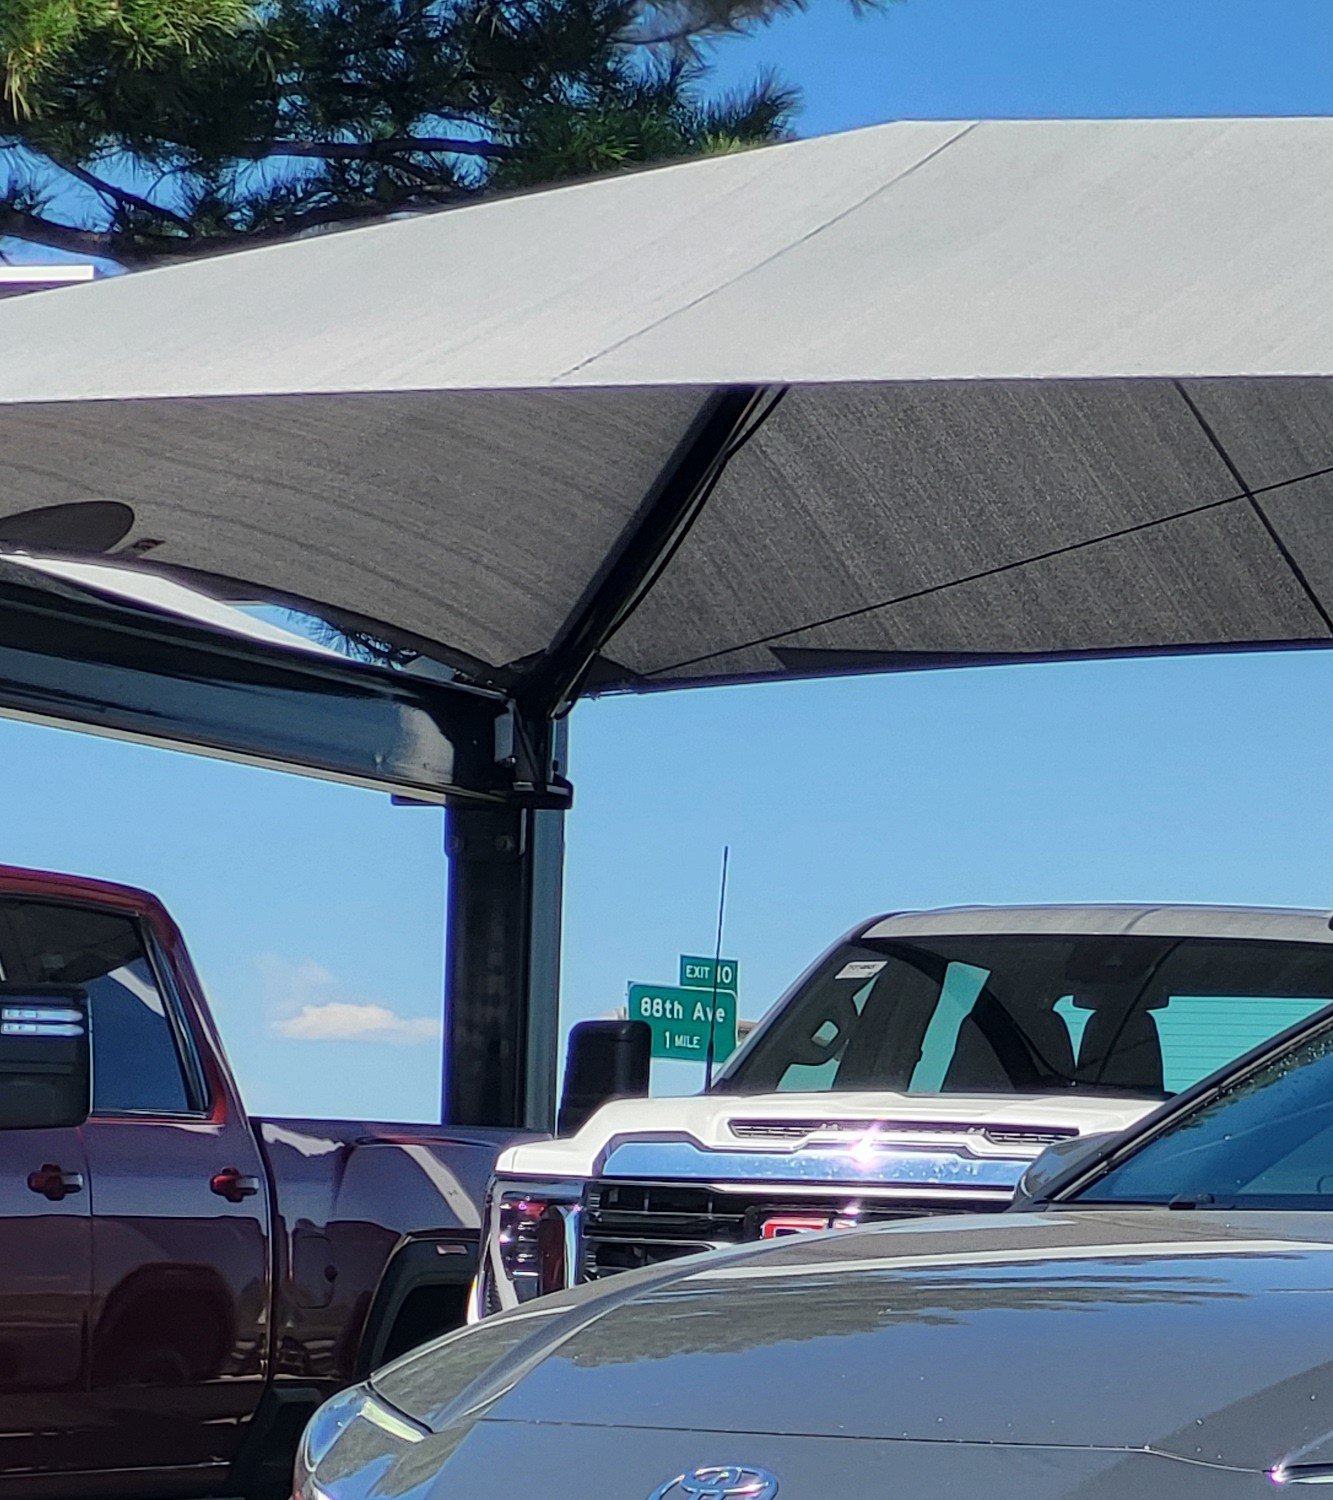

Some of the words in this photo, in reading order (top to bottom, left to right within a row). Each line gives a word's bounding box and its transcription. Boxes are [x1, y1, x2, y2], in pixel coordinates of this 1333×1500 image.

[685, 964, 710, 979] EXIT
[716, 965, 732, 984] 10
[640, 996, 684, 1020] 88th
[692, 1001, 726, 1023] Ave
[664, 1030, 671, 1050] 1
[674, 1034, 701, 1050] MILE
